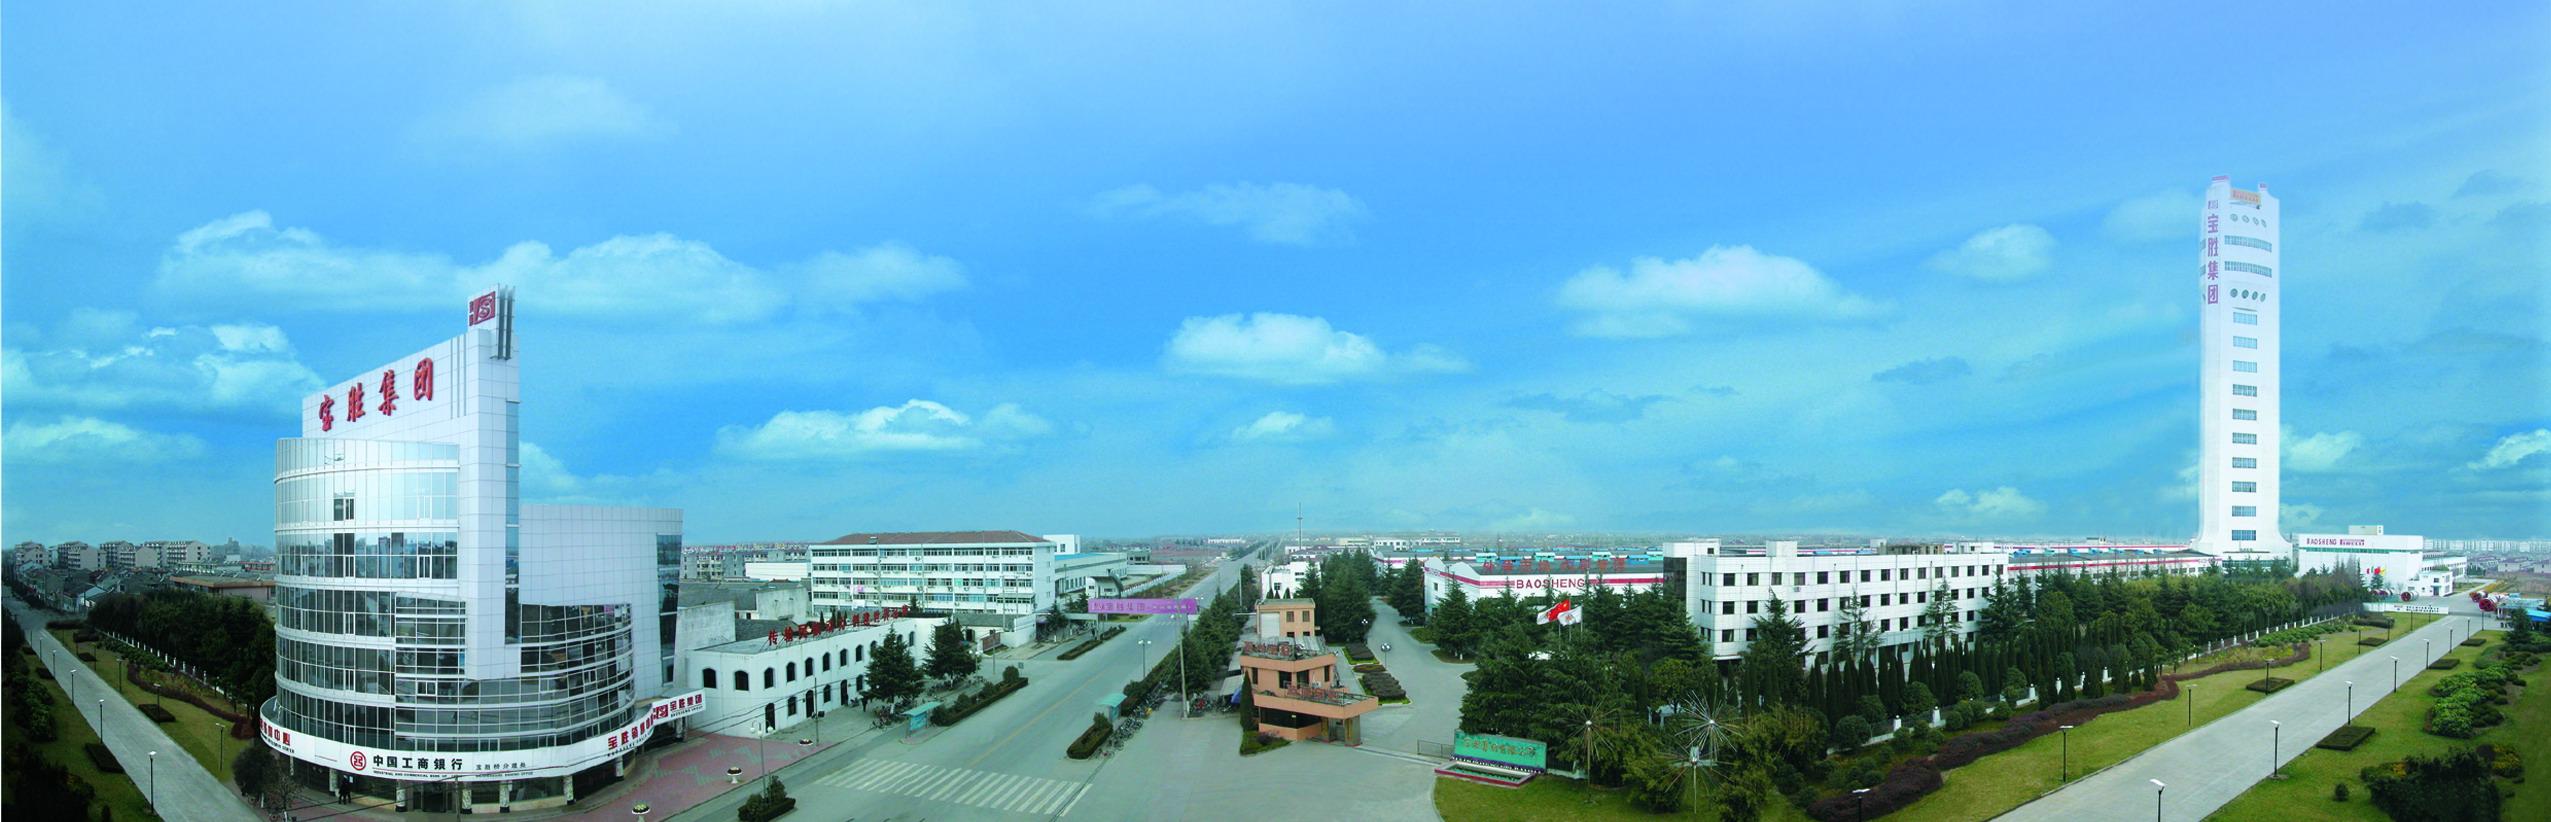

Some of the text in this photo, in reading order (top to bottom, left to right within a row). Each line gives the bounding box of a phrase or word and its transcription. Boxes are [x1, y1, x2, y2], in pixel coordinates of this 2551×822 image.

[2207, 213, 2219, 305] 宝胜集团
[319, 357, 434, 432] 宝胜集团
[2306, 538, 2337, 546] BAOSHENG
[1516, 578, 1585, 589] BAOSHENG
[372, 755, 463, 771] 中国工商银行
